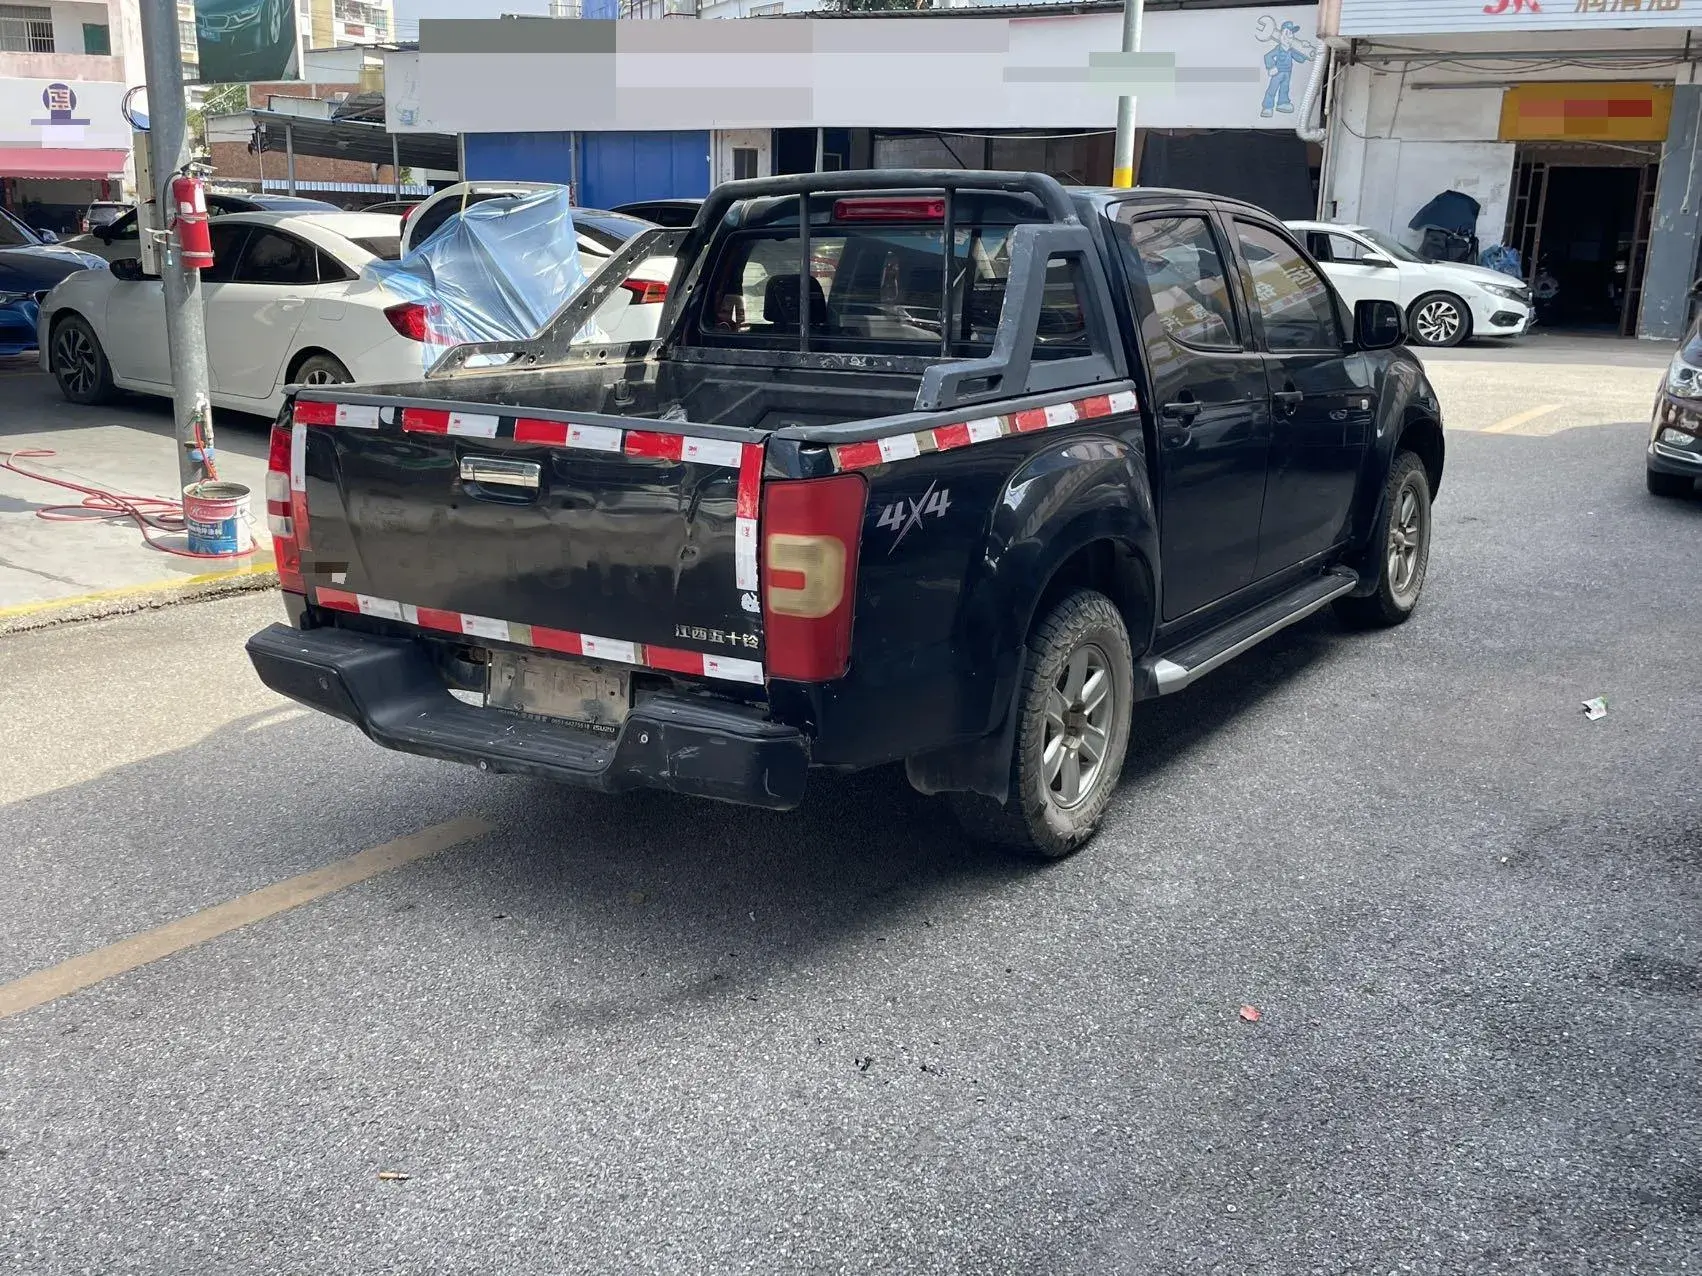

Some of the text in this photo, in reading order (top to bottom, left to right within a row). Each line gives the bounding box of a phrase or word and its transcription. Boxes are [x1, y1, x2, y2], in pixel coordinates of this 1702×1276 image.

[675, 624, 759, 650] 江西五十铃
